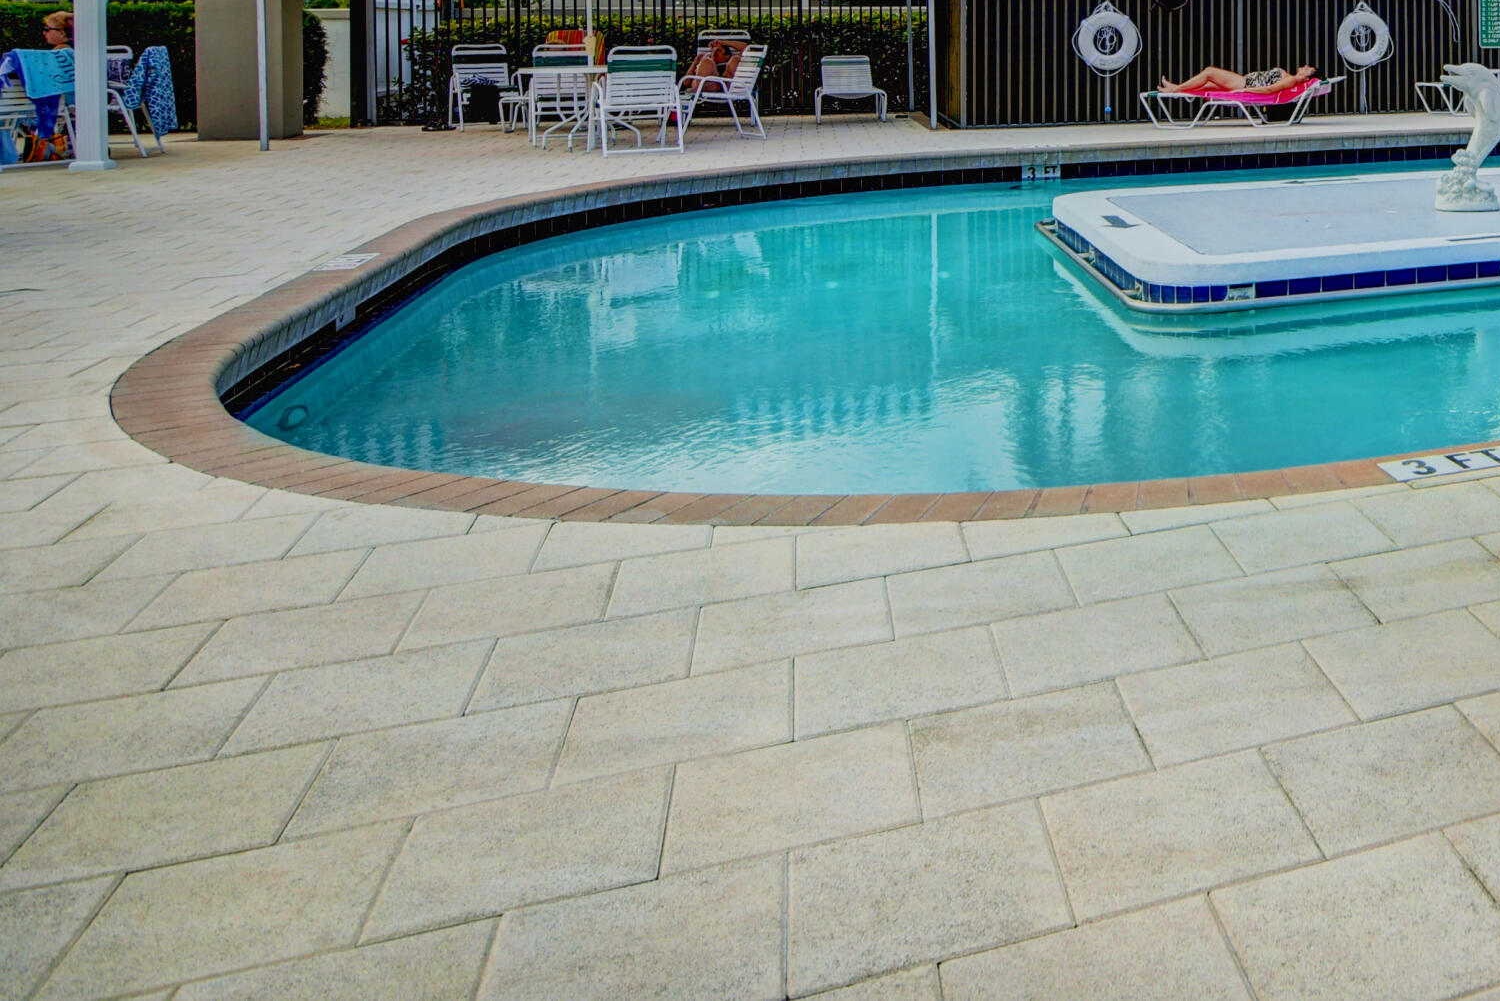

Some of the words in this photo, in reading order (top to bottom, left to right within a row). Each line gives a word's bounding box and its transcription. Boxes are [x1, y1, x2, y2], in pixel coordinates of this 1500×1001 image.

[1027, 166, 1036, 181] 3
[1044, 165, 1058, 179] FT
[1401, 459, 1437, 476] 3
